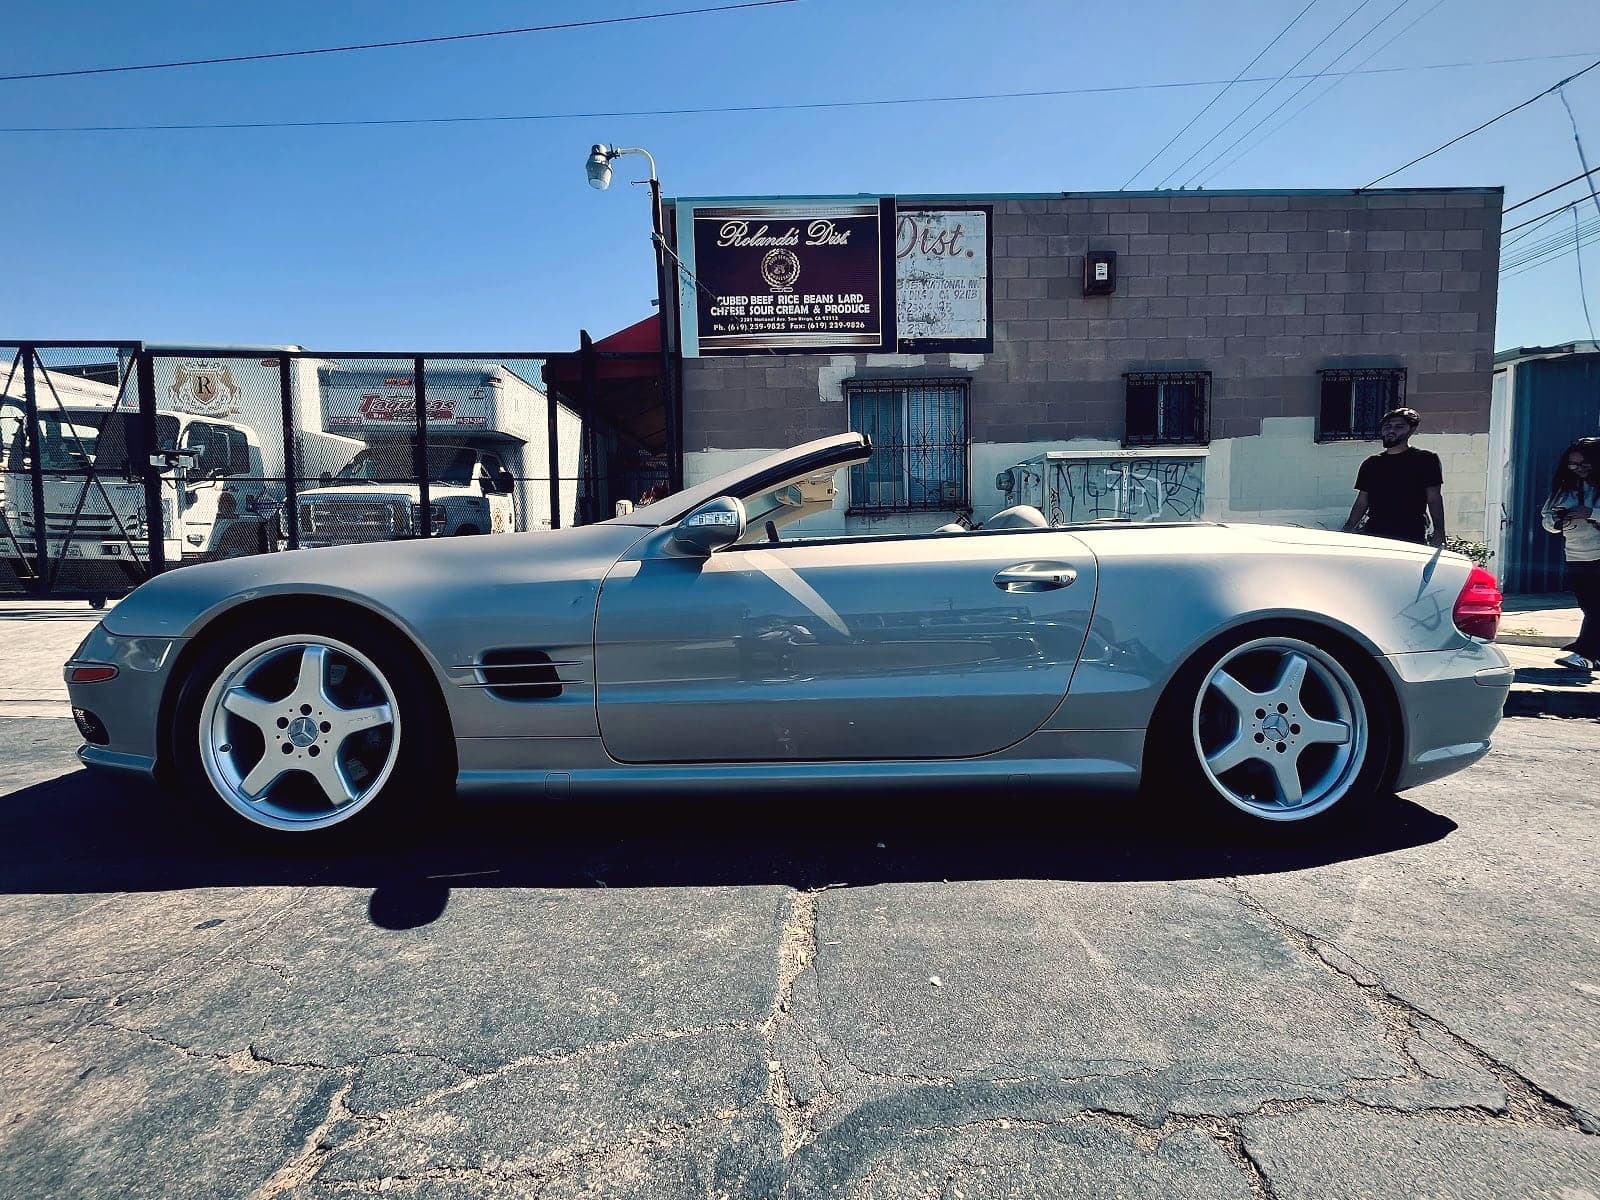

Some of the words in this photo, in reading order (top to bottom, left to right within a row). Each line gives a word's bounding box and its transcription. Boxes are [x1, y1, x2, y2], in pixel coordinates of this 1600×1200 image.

[717, 220, 800, 247] Rolando's
[716, 295, 749, 306] CUBED
[750, 295, 774, 305] BEEF
[777, 294, 800, 305] RICE
[803, 294, 834, 304] BEANS
[837, 293, 864, 304] LARD
[710, 306, 746, 316] CHEESE
[749, 305, 775, 315] SOUR
[775, 304, 809, 315] CREAM
[812, 304, 821, 314] &
[824, 303, 871, 314] PRODUCE
[713, 323, 726, 331] Ph.
[749, 322, 786, 330] 239-9825
[807, 322, 827, 330] (619)
[196, 375, 214, 395] R
